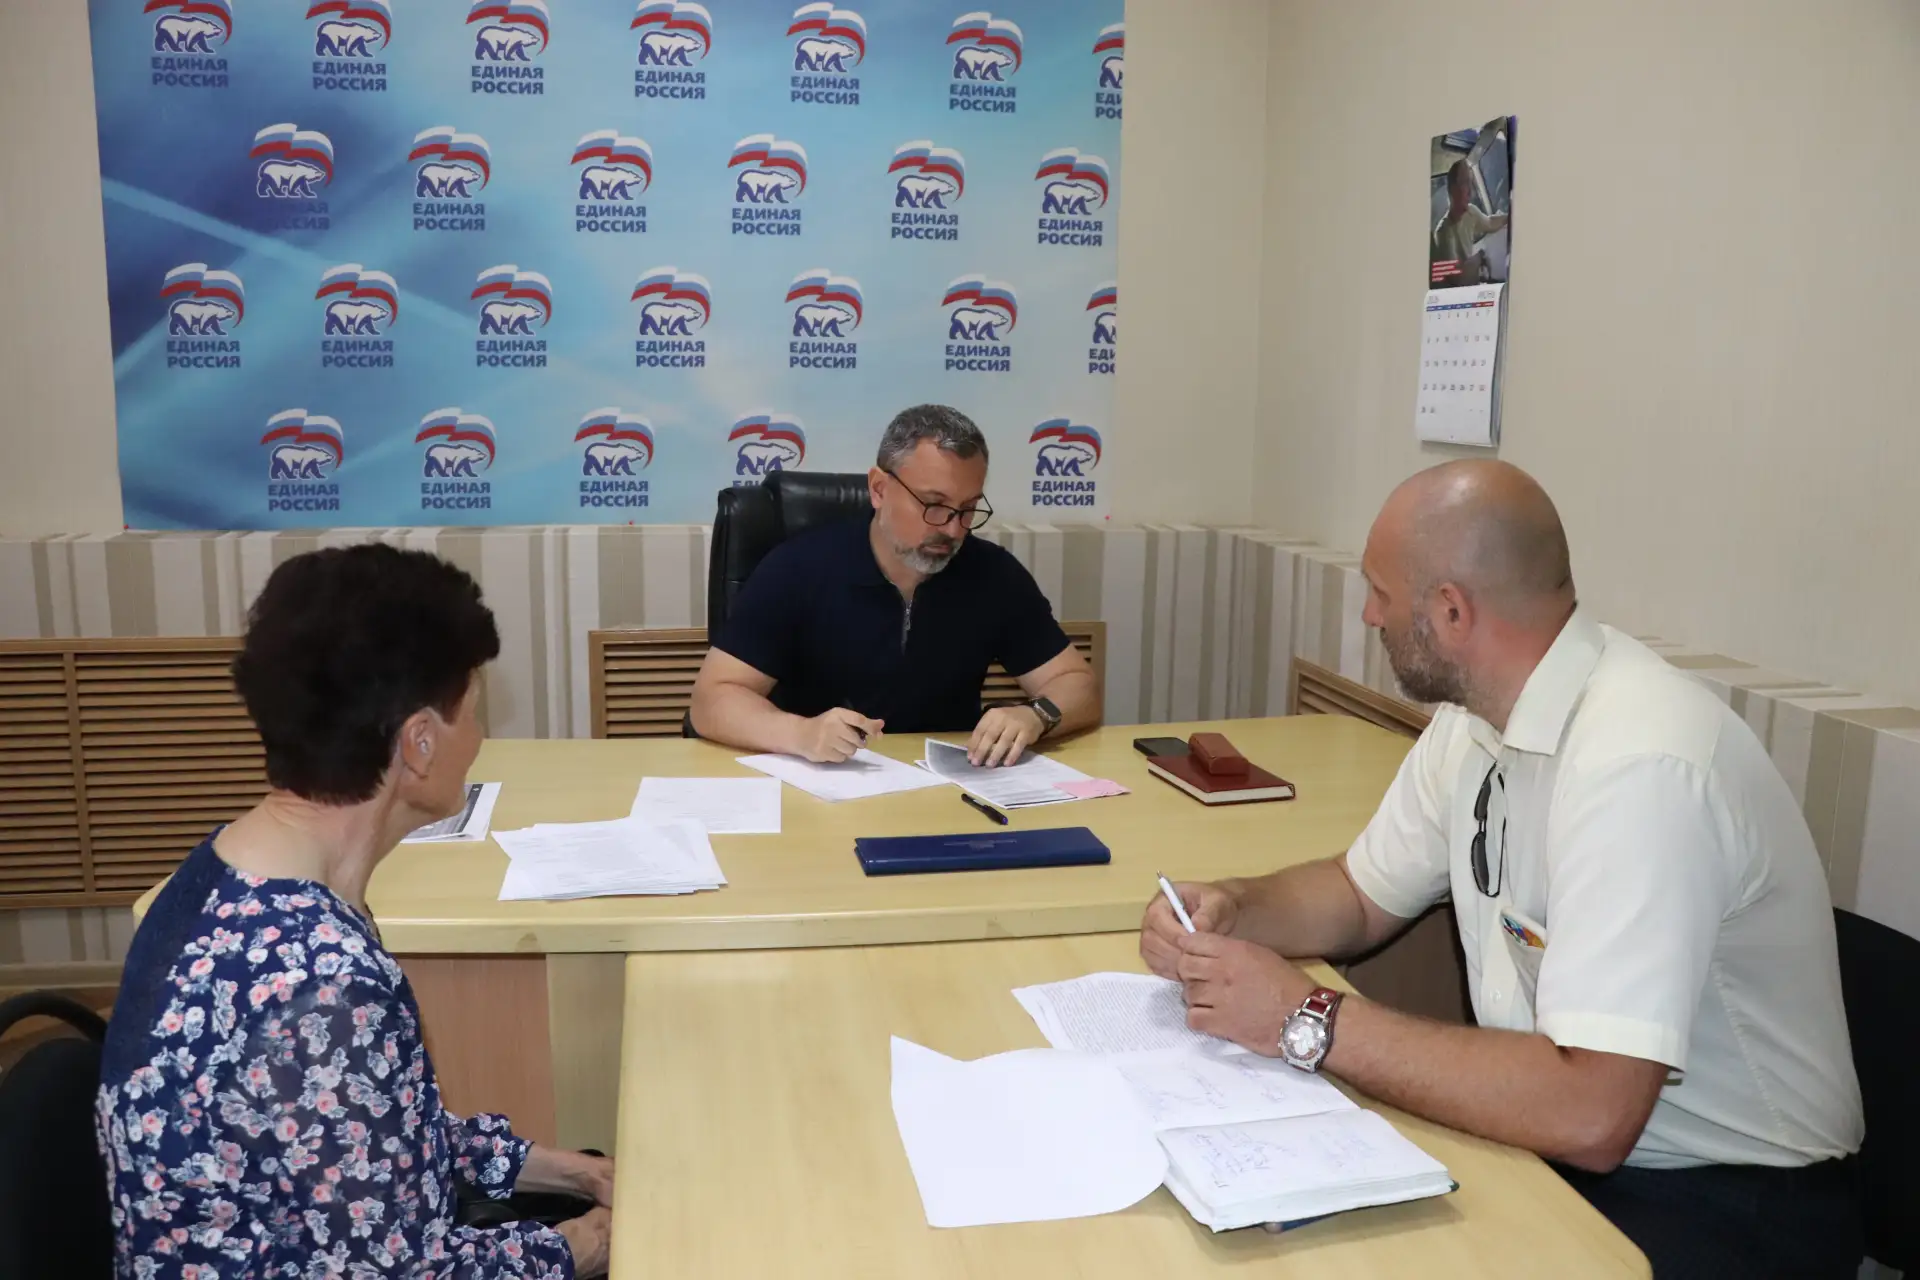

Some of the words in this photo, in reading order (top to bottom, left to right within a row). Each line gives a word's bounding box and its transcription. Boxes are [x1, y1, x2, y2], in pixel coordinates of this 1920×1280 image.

[151, 57, 229, 71] ЕДИНАЯ
[312, 61, 387, 75] ЕДИНАЯ
[471, 65, 544, 79] ЕДИНАЯ
[634, 70, 706, 83] ЕДИНАЯ
[151, 71, 229, 88] РОССИЯ
[312, 75, 387, 92] РОССИЯ
[790, 76, 860, 89] ЕДИНАЯ
[471, 79, 544, 95] РОССИЯ
[634, 83, 706, 100] РОССИЯ
[949, 83, 1017, 97] ЕДИНАЯ
[790, 89, 860, 105] РОССИЯ
[949, 97, 1017, 113] РОССИЯ
[412, 202, 486, 216] ЕДИНАЯ
[575, 204, 647, 218] ЕДИНАЯ
[731, 207, 801, 220] ЕДИНАЯ
[412, 216, 486, 231] РОССИЯ
[575, 218, 647, 233] РОССИЯ
[891, 212, 959, 225] ЕДИНАЯ
[1037, 218, 1103, 231] ЕДИНАЯ
[731, 220, 801, 236] РОССИЯ
[891, 225, 959, 241] РОССИЯ
[1037, 231, 1103, 246] РОССИЯ
[166, 340, 241, 353] ЕДИНАЯ
[321, 340, 394, 353] ЕДИНАЯ
[476, 339, 547, 353] ЕДИНАЯ
[635, 340, 705, 353] ЕДИНАЯ
[789, 341, 857, 354] ЕДИНАЯ
[945, 344, 1011, 357] ЕДИНАЯ
[166, 353, 241, 369] РОССИЯ
[321, 353, 394, 368] РОССИЯ
[476, 353, 547, 368] РОССИЯ
[635, 353, 705, 368] РОССИЯ
[789, 354, 857, 369] РОССИЯ
[945, 357, 1011, 372] РОССИЯ
[267, 483, 340, 497] ЕДИНАЯ
[420, 482, 491, 495] ЕДИНАЯ
[579, 480, 649, 493] ЕДИНАЯ
[1032, 480, 1096, 492] ЕДИНАЯ
[267, 497, 340, 512] РОССИЯ
[420, 495, 491, 510] РОССИЯ
[579, 493, 649, 508] РОССИЯ
[1032, 492, 1096, 506] РОССИЯ
